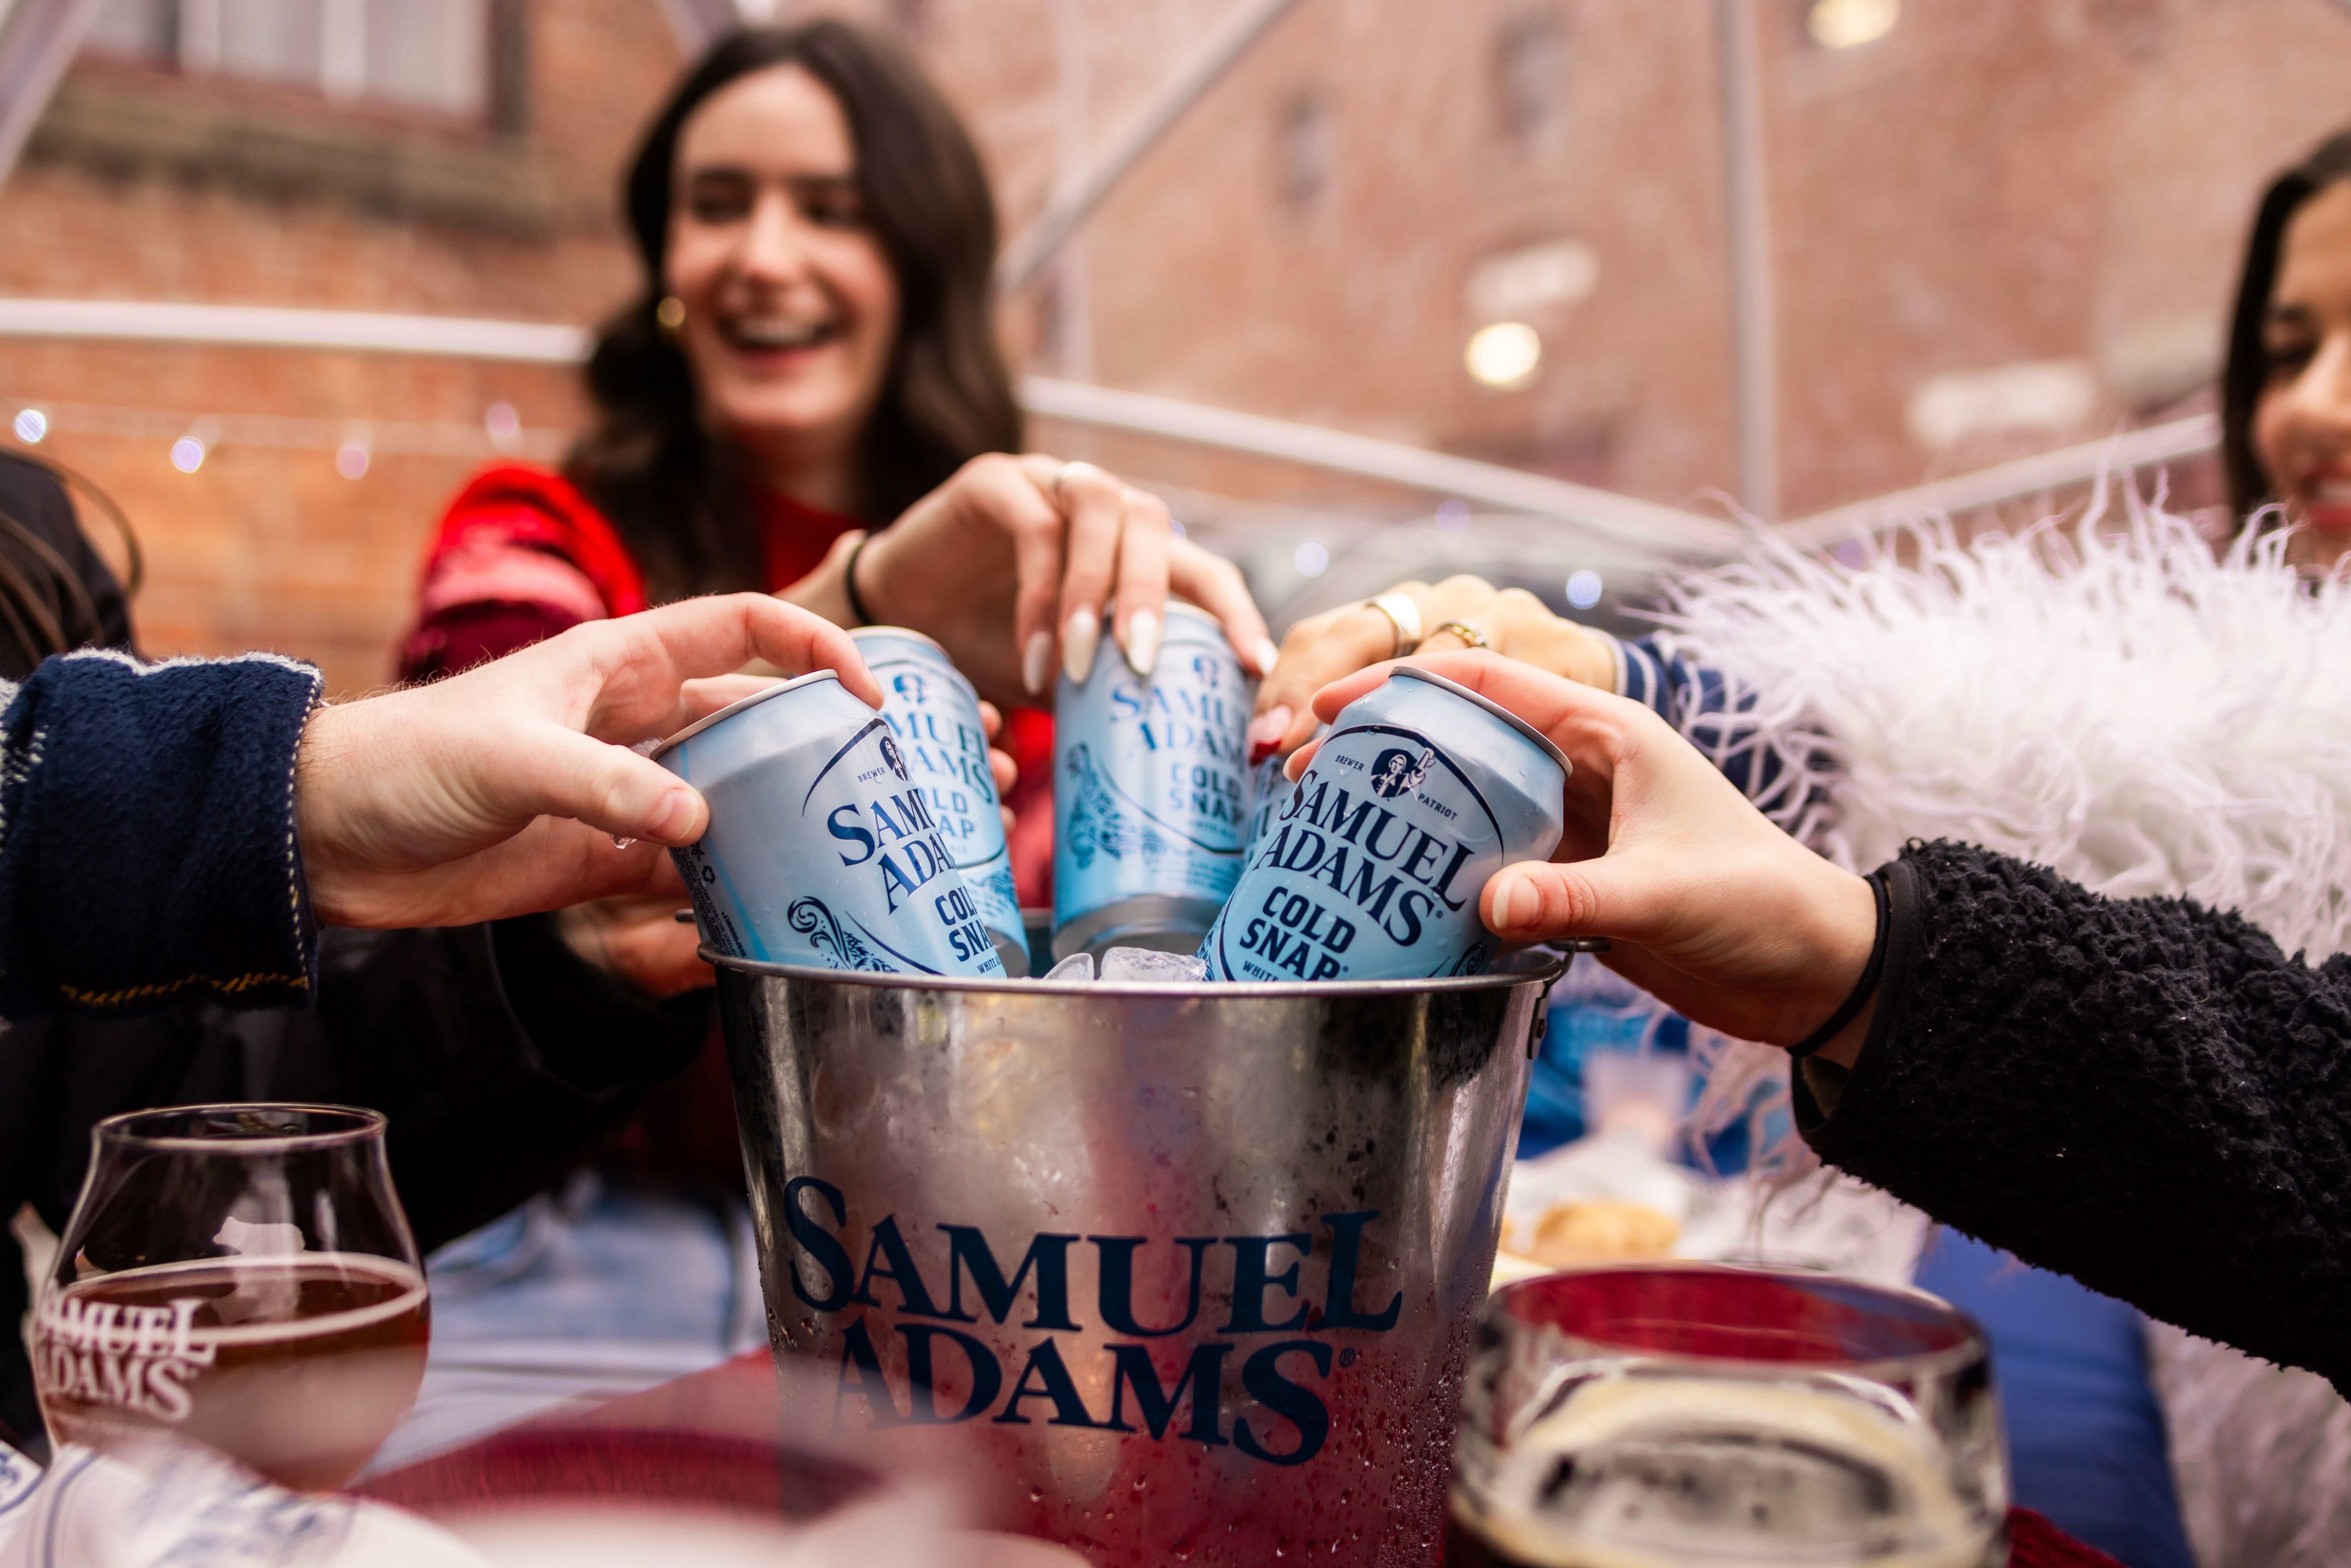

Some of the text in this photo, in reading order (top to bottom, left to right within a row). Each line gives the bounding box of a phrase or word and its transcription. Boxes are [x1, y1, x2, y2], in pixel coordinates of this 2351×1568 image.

[882, 713, 985, 765] MUEL
[1129, 722, 1245, 774] ADAM
[858, 767, 885, 783] BREWER
[899, 745, 993, 804] AMS
[1170, 762, 1241, 801] COLD
[1335, 755, 1364, 771] BREWER
[939, 814, 974, 838] AP
[1418, 793, 1457, 820] PATRIOT
[1279, 769, 1475, 912] SAMUEL
[935, 886, 977, 926] COL
[1262, 886, 1356, 953] COLD
[949, 918, 993, 962] SNA
[1239, 918, 1340, 981] SNAP
[977, 958, 997, 974] WHITE
[783, 1176, 1403, 1336] SAMUEL
